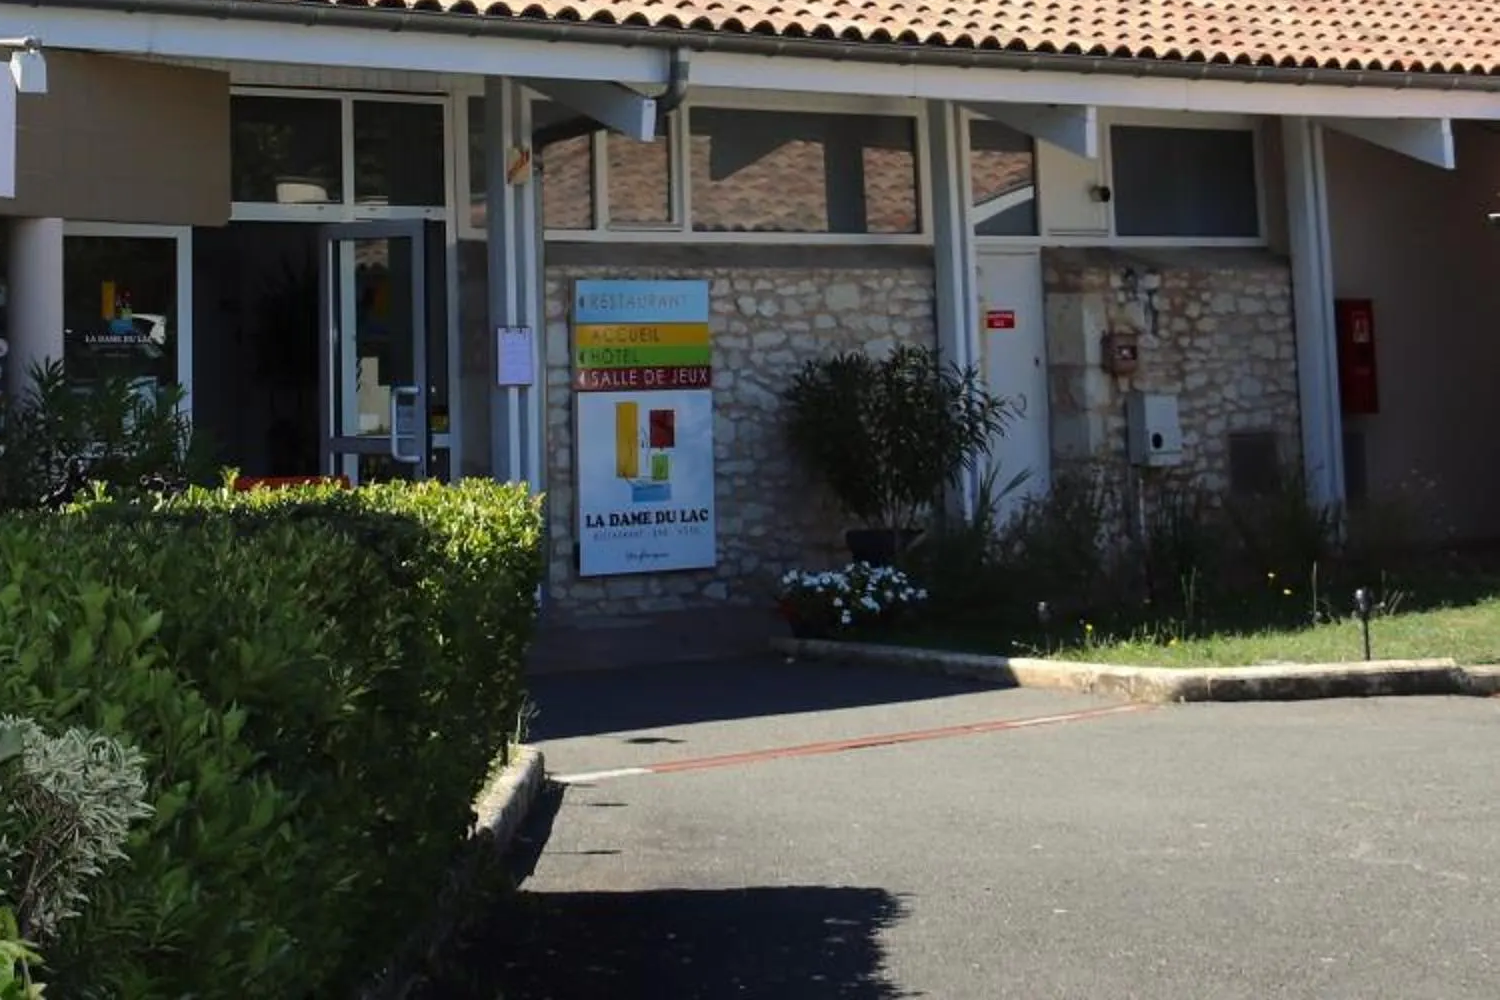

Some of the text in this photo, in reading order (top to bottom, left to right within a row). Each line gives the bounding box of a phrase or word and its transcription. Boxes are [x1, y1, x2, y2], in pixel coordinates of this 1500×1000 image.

[591, 368, 708, 387] SALLE DE JEUX
[585, 508, 709, 528] LA DAME DU LAC
